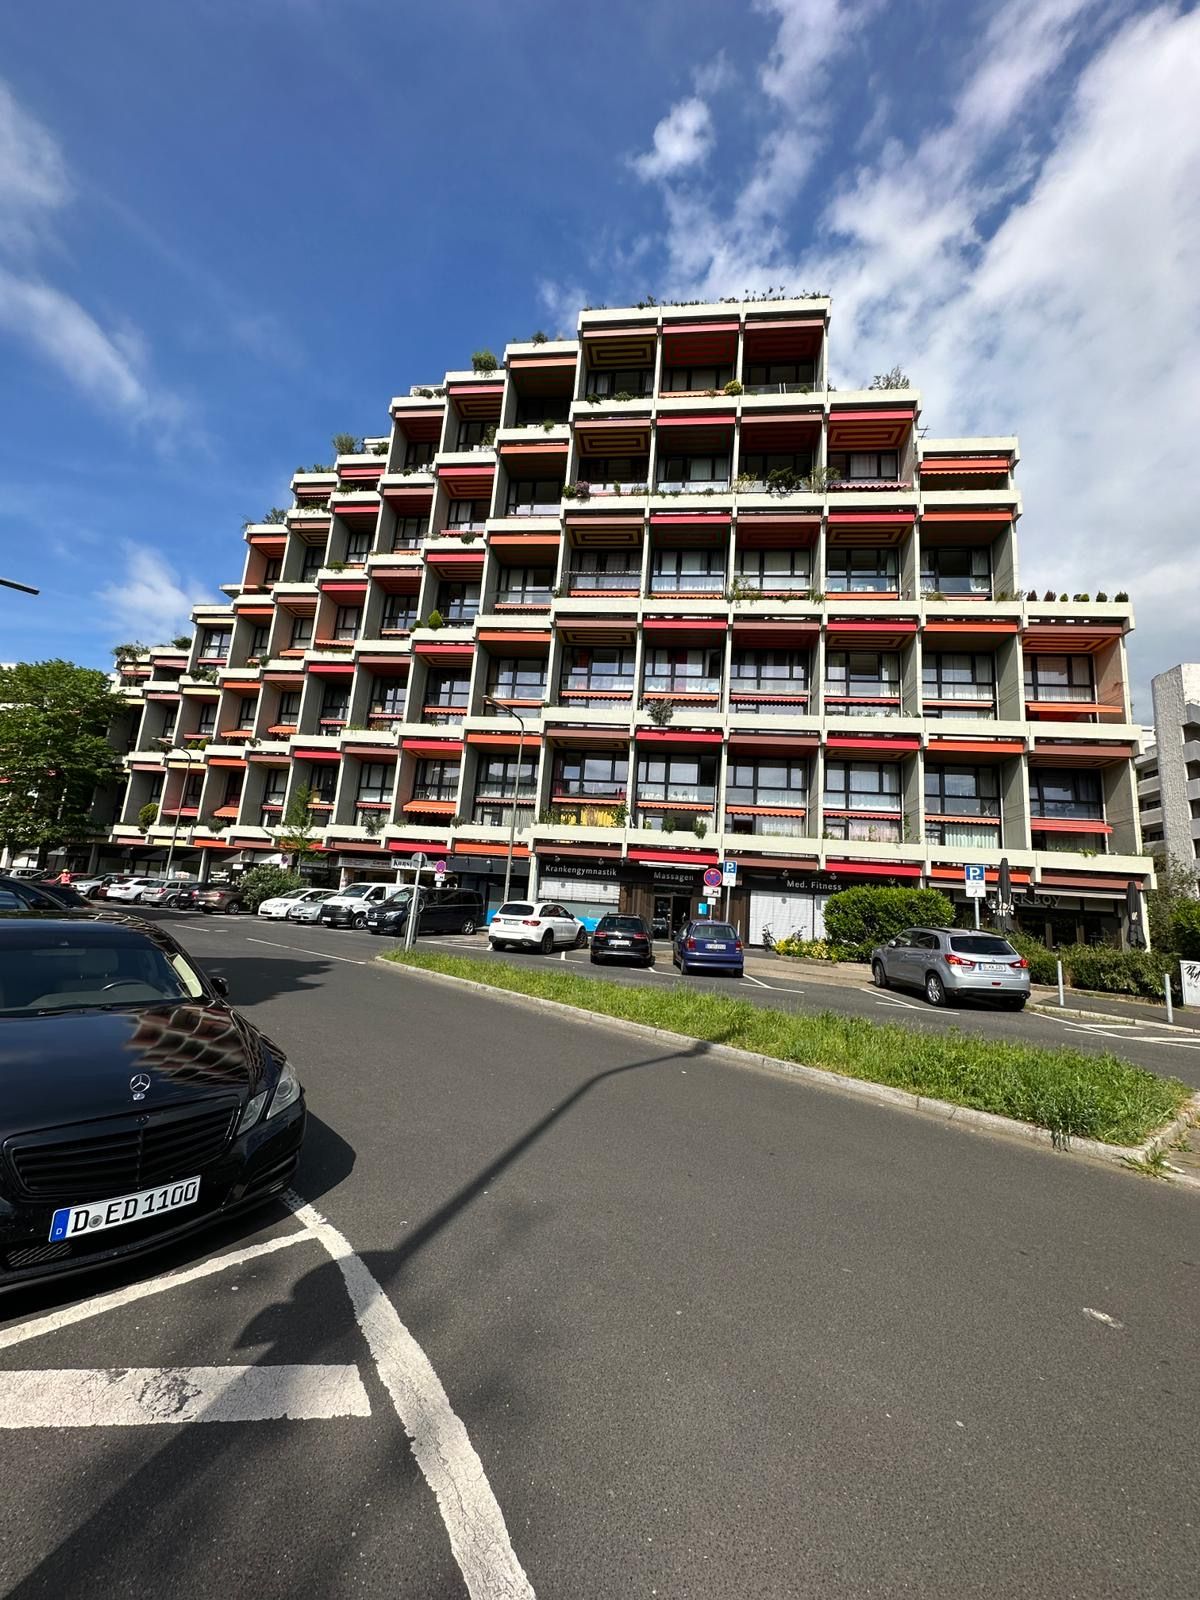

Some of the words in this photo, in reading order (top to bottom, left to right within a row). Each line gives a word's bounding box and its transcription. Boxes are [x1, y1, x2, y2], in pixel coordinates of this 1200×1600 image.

[545, 864, 617, 876] Krankengymnastik
[726, 862, 735, 873] P
[969, 867, 981, 880] P
[653, 871, 694, 882] Massagen
[786, 879, 808, 889] Med.
[810, 880, 843, 891] Fitness
